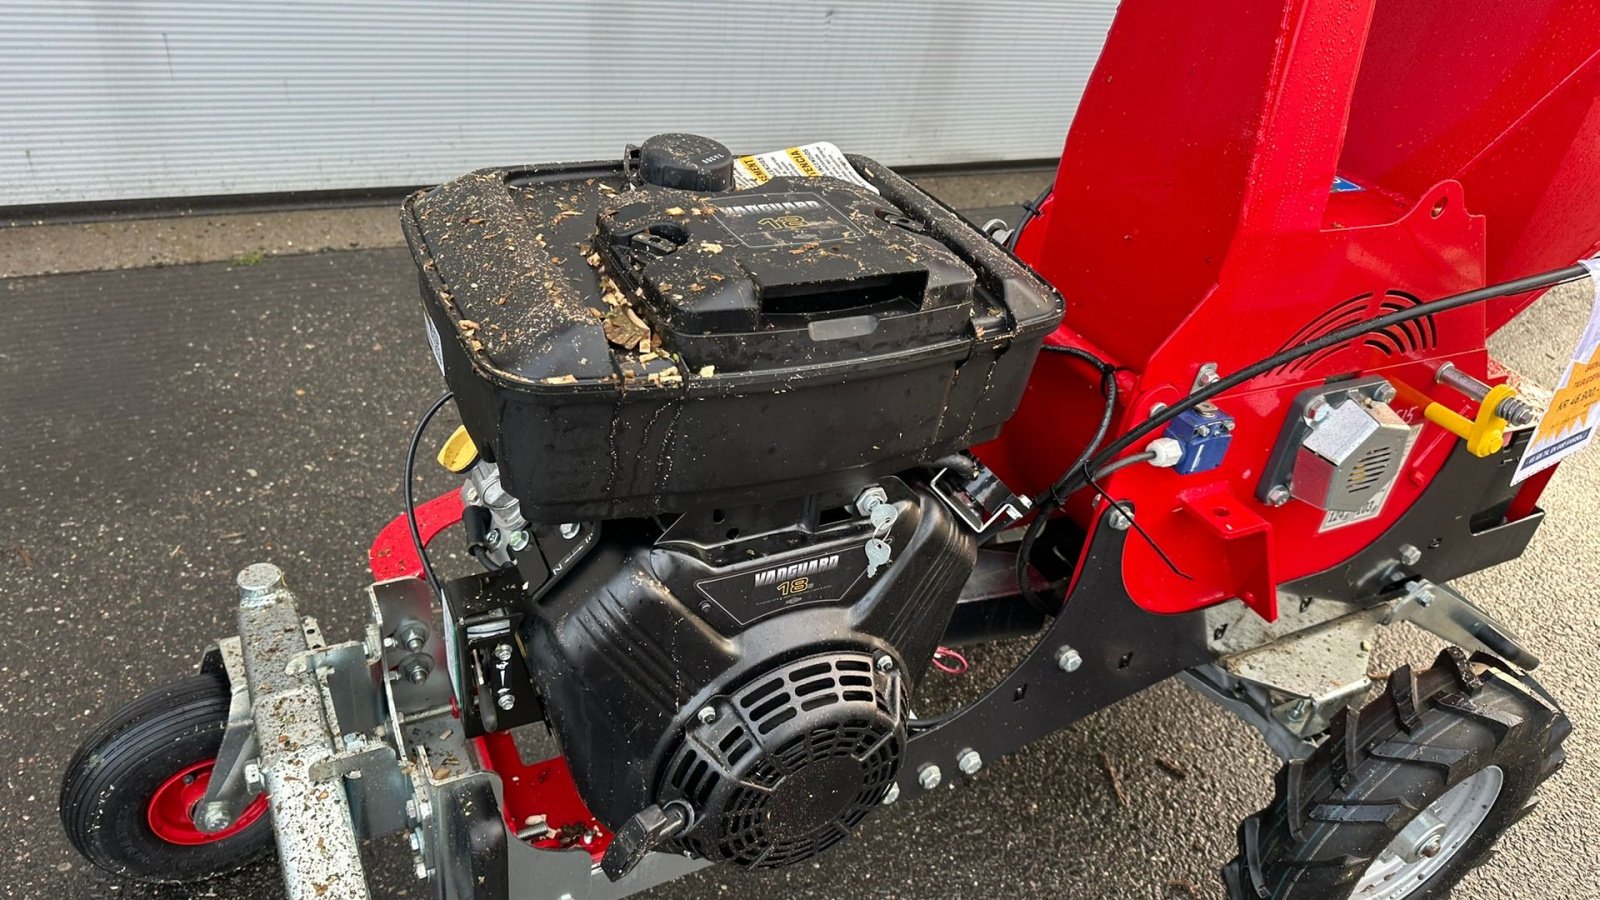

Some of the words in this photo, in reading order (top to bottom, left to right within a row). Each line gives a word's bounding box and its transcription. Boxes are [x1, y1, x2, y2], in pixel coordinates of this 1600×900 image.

[757, 215, 811, 230] 18
[754, 554, 840, 588] VANGUARD
[776, 576, 809, 597] 18
